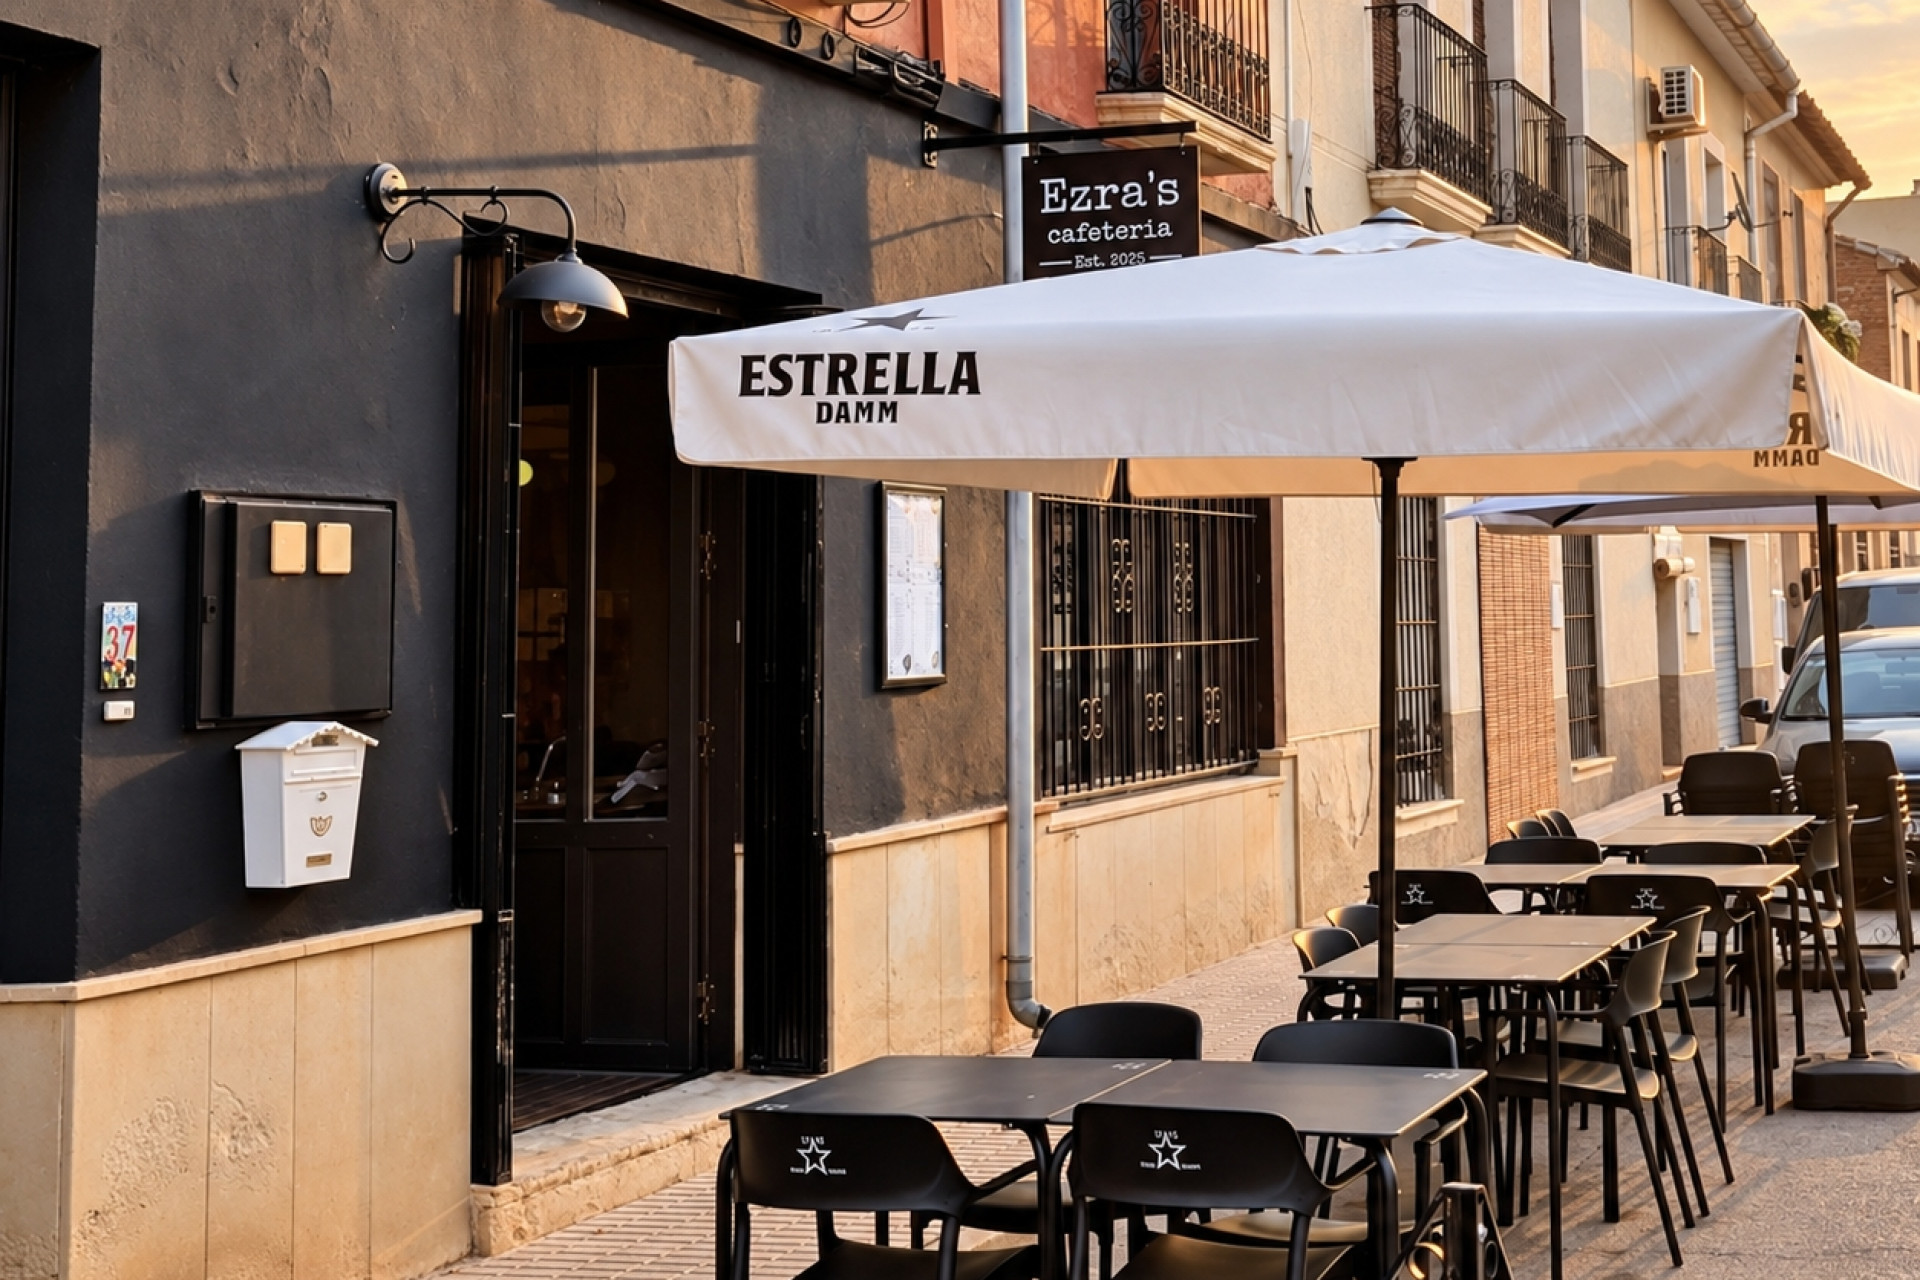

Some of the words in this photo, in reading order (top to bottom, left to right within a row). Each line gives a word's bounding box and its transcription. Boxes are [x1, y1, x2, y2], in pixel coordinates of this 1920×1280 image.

[1039, 170, 1180, 214] Ezra's
[1047, 219, 1174, 244] cafeteria
[1074, 254, 1106, 269] Est.
[1109, 250, 1146, 266] 2025
[738, 351, 981, 397] ESTRELLA
[815, 400, 898, 424] DAMM
[106, 624, 136, 663] 37
